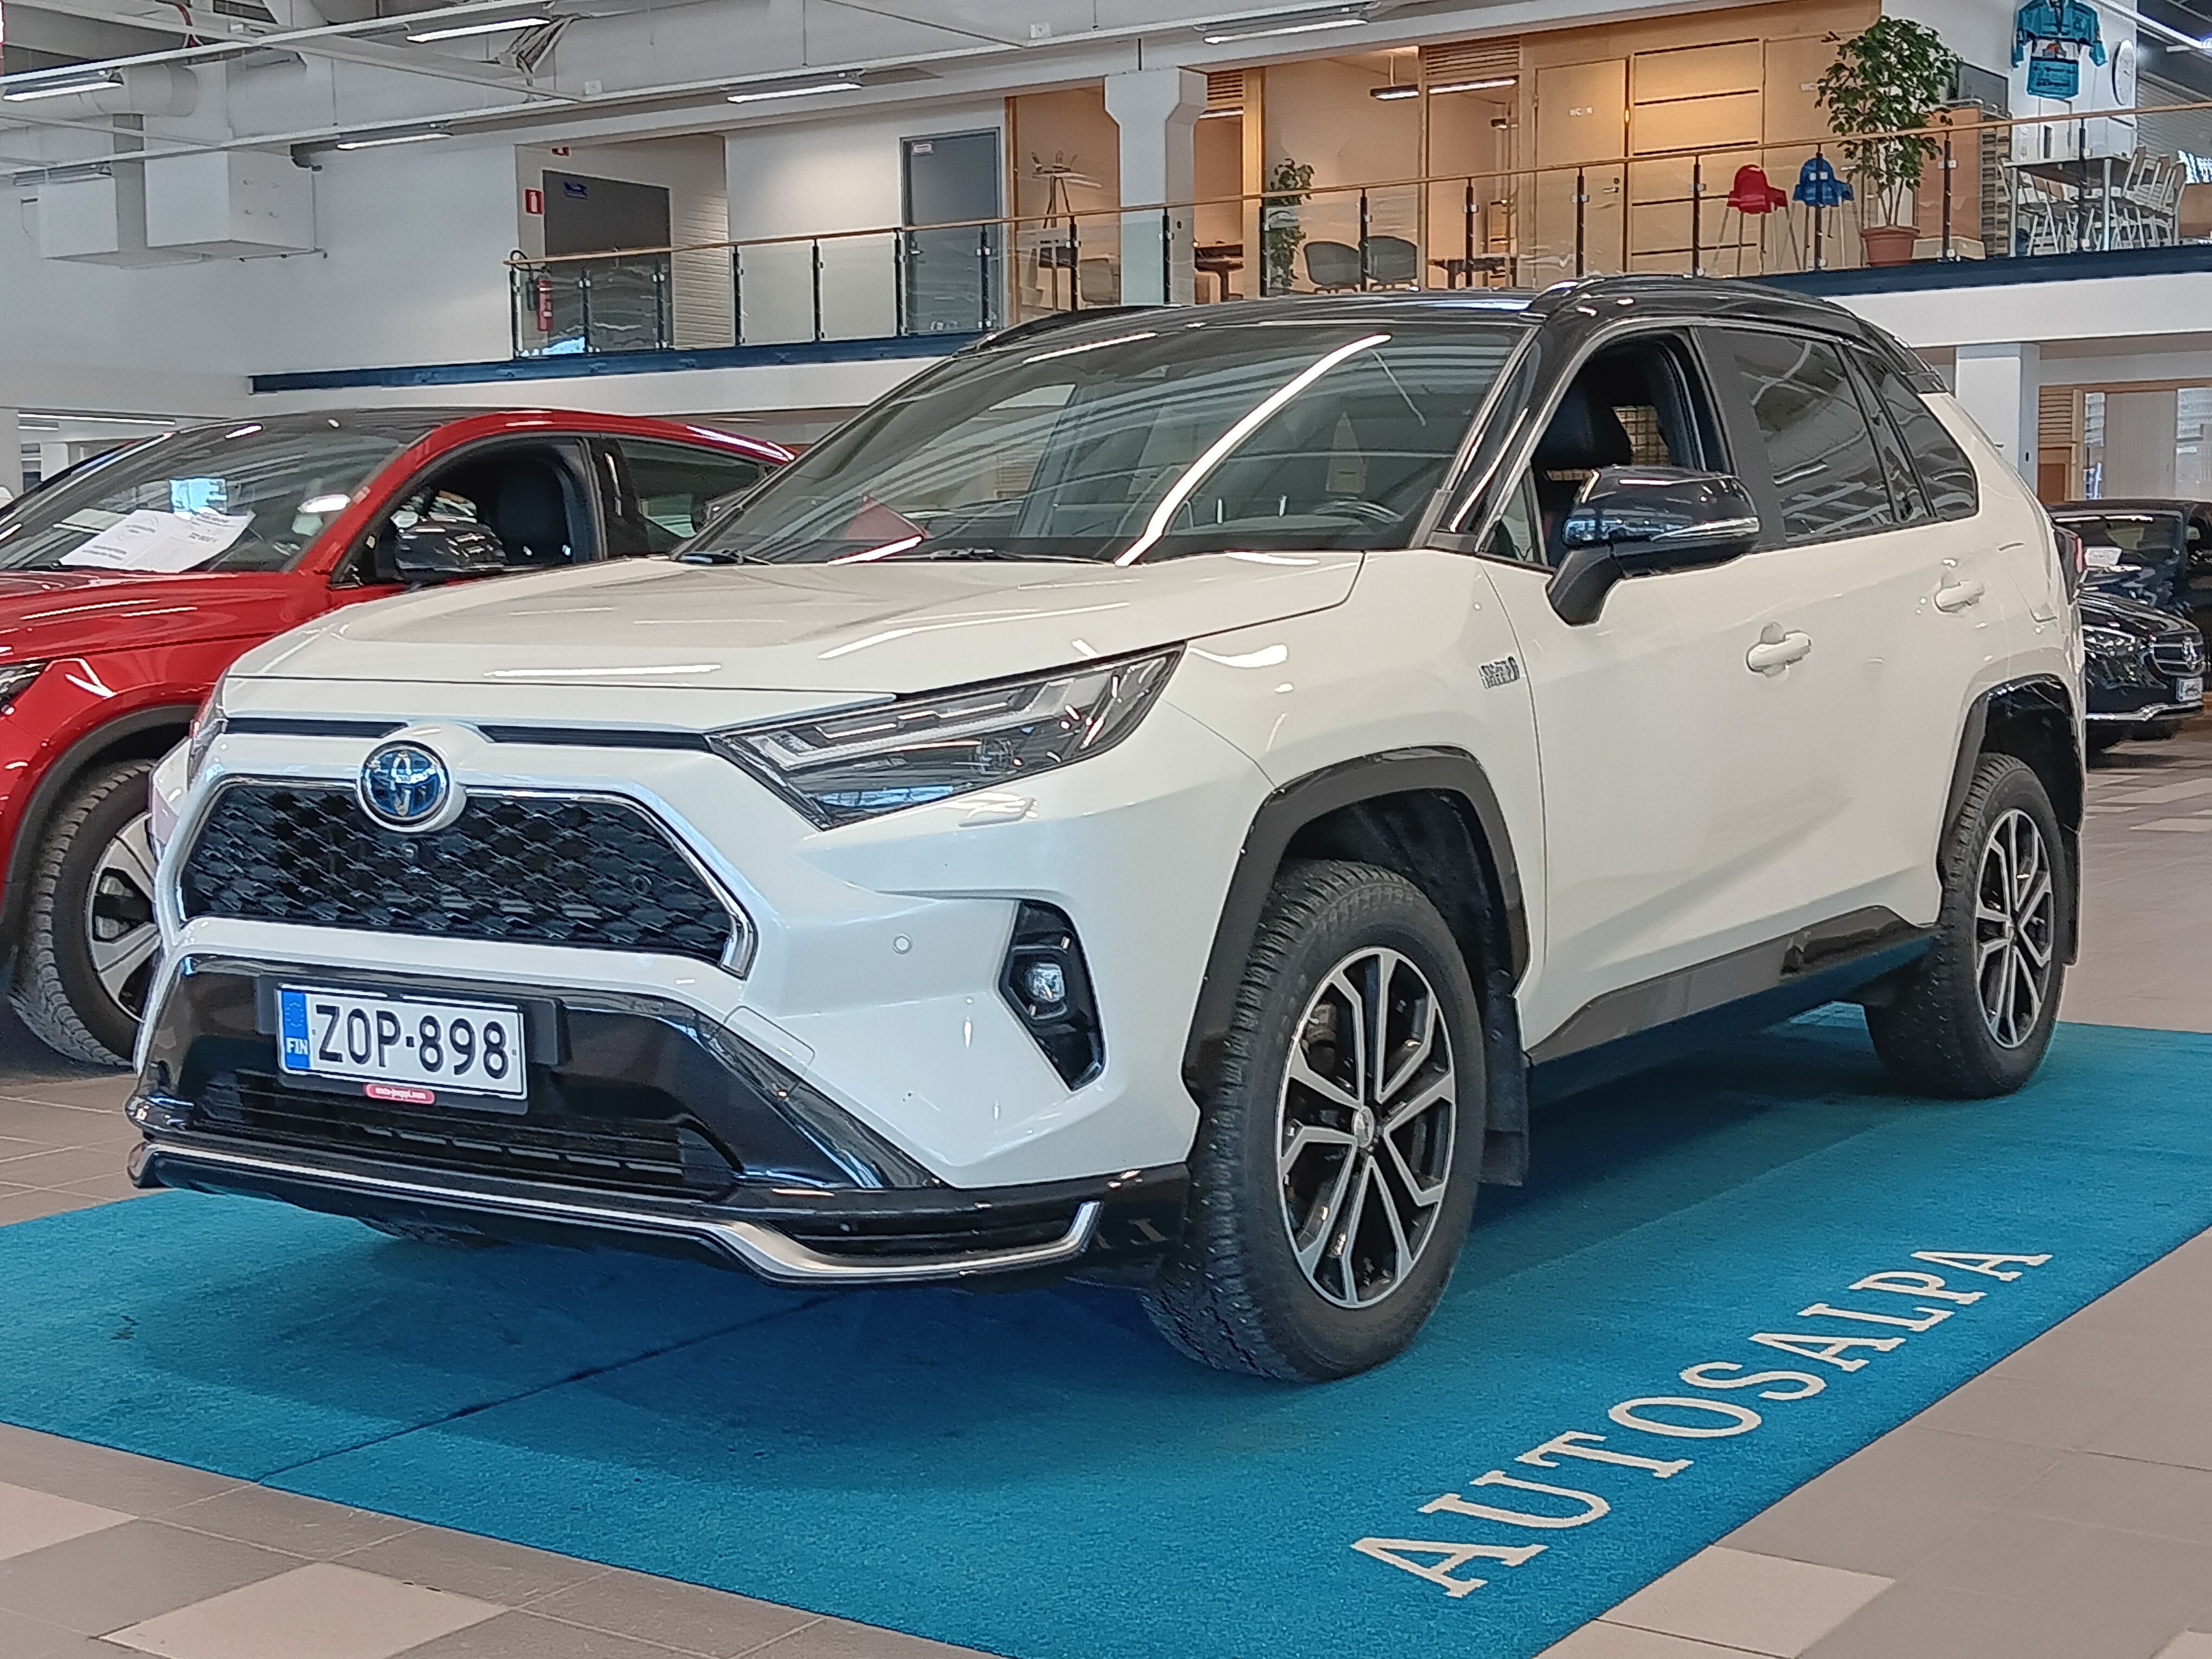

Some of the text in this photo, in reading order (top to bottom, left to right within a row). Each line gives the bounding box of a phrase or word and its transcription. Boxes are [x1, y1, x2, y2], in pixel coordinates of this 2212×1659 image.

[286, 1037, 308, 1056] FIN
[316, 1004, 509, 1079] ZOP-898
[1350, 1250, 2053, 1598] AUTOSALPA
